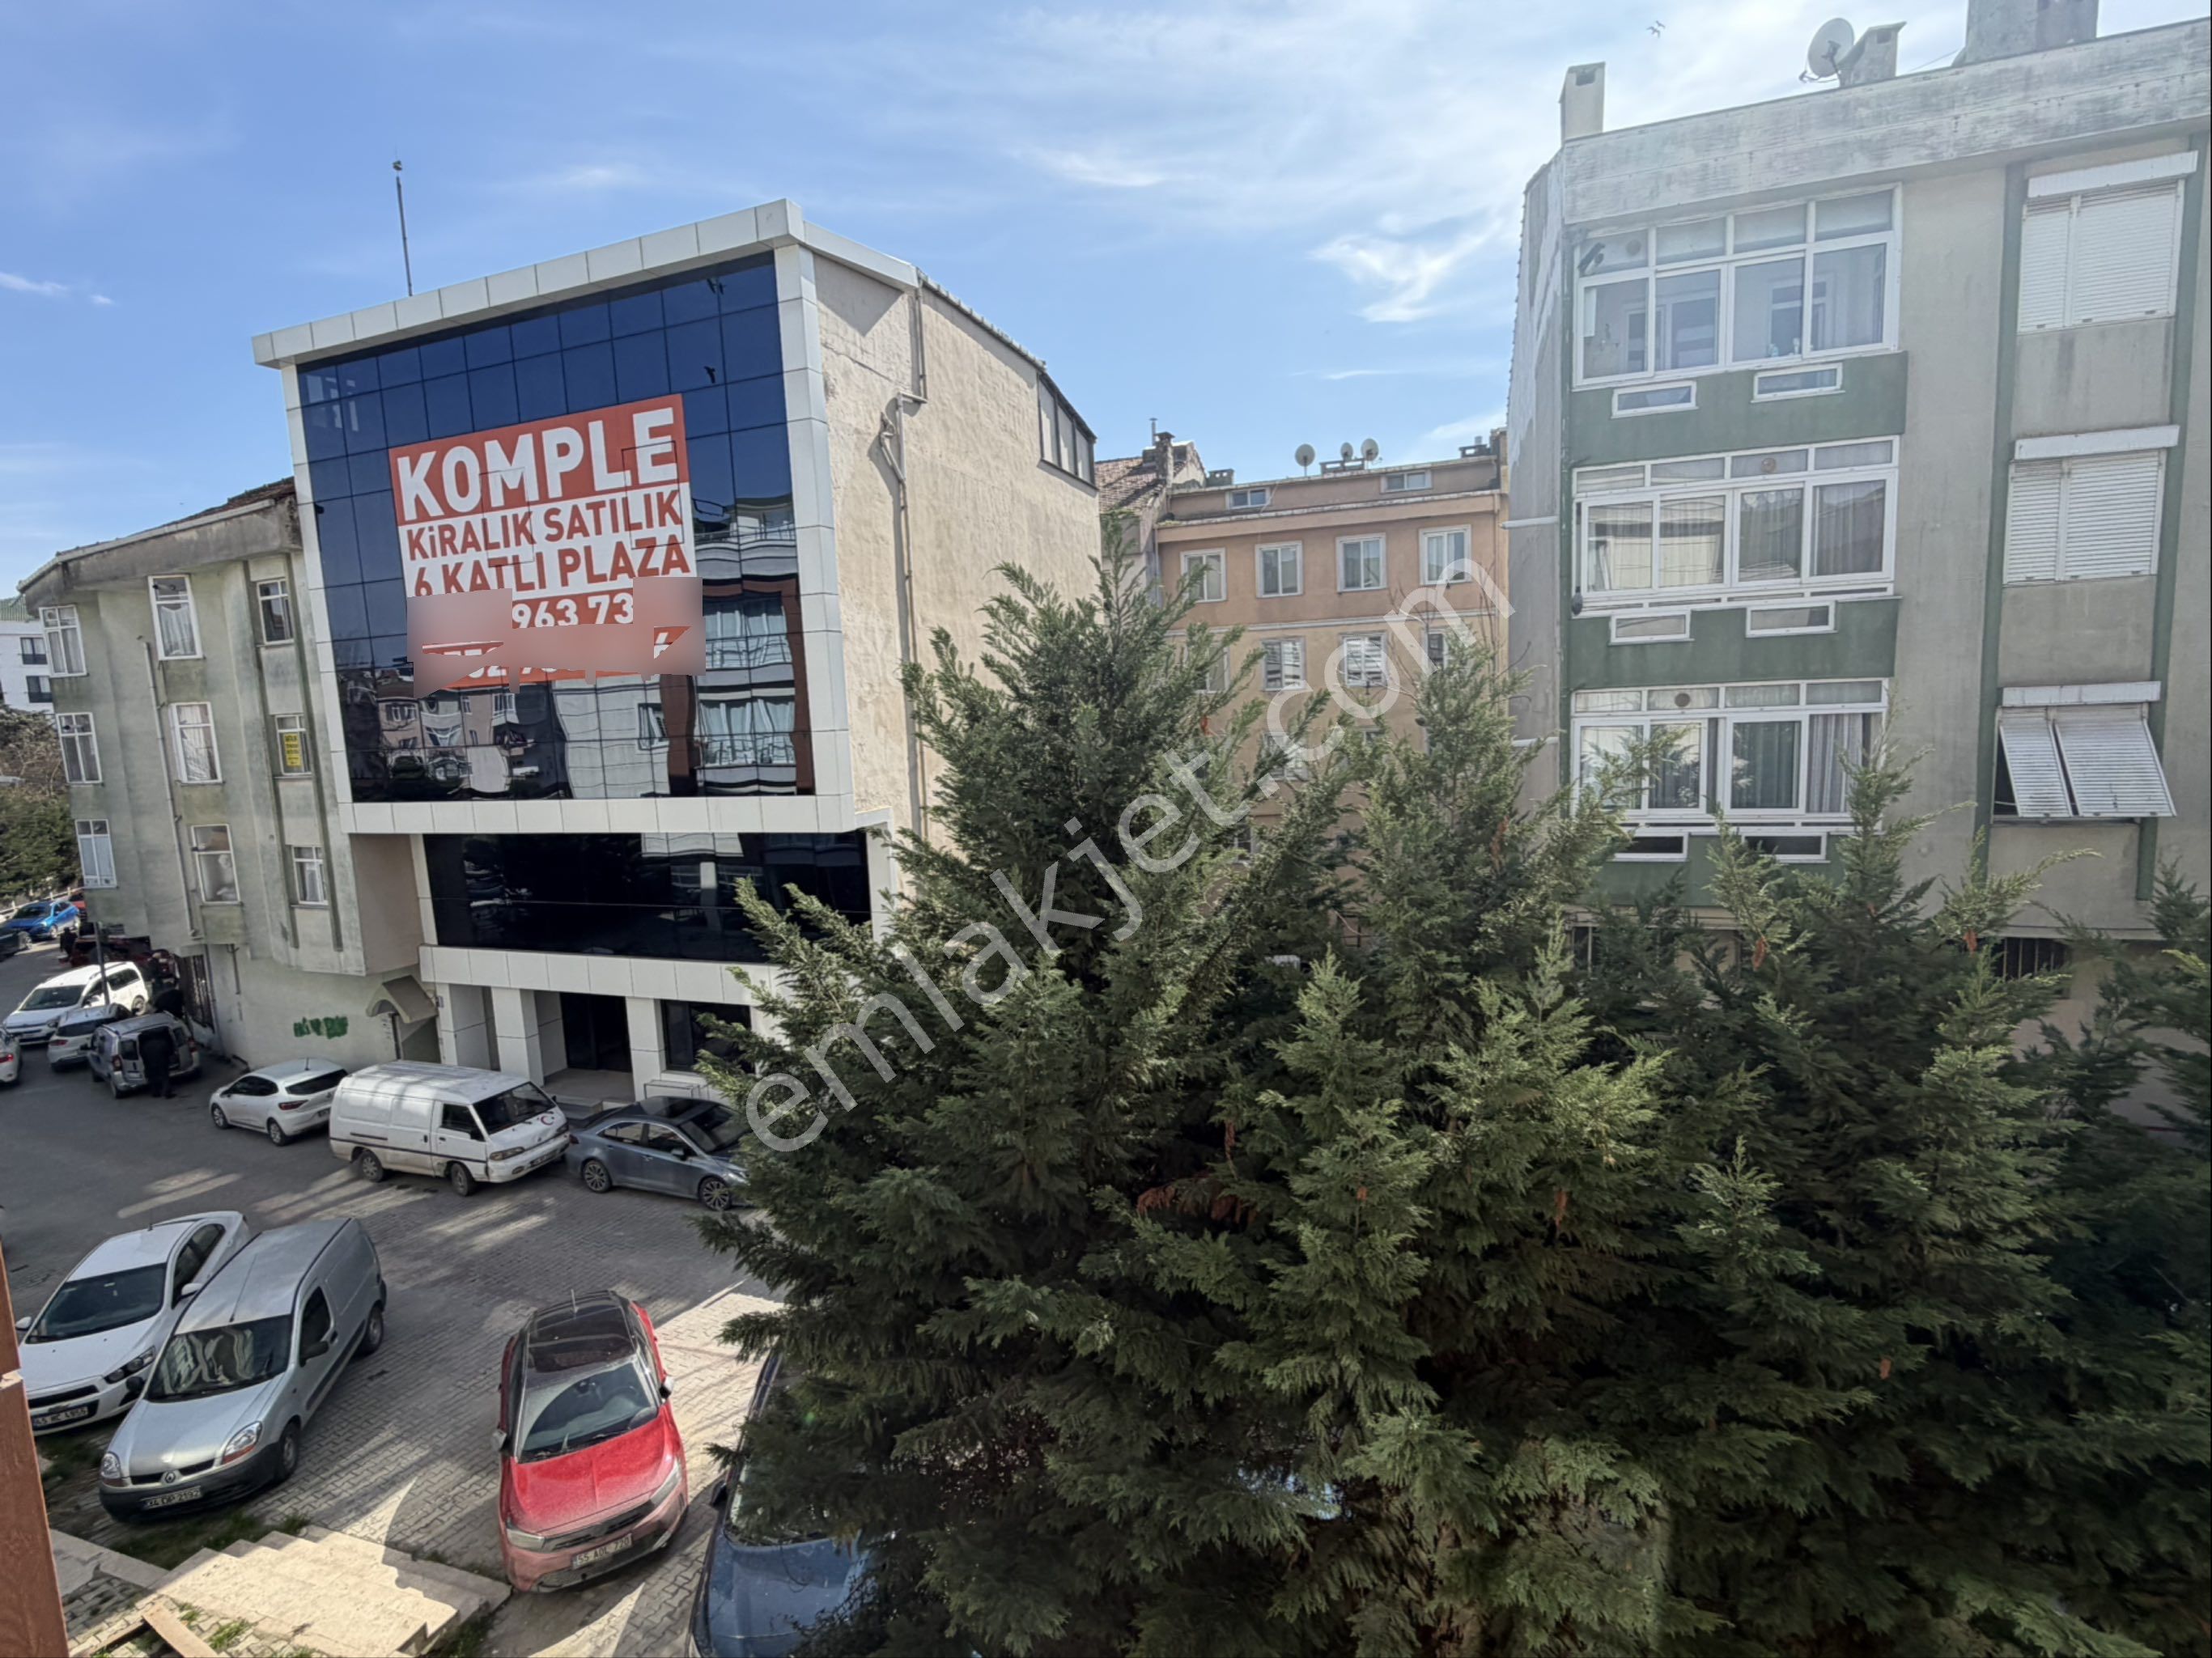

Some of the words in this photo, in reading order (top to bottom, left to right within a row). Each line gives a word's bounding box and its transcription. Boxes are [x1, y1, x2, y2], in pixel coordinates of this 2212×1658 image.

[397, 407, 678, 521] KOMPLE
[543, 490, 683, 542] SATILIK
[414, 567, 433, 597] 6
[442, 552, 547, 596] KATLI
[558, 534, 690, 587] PLAZA
